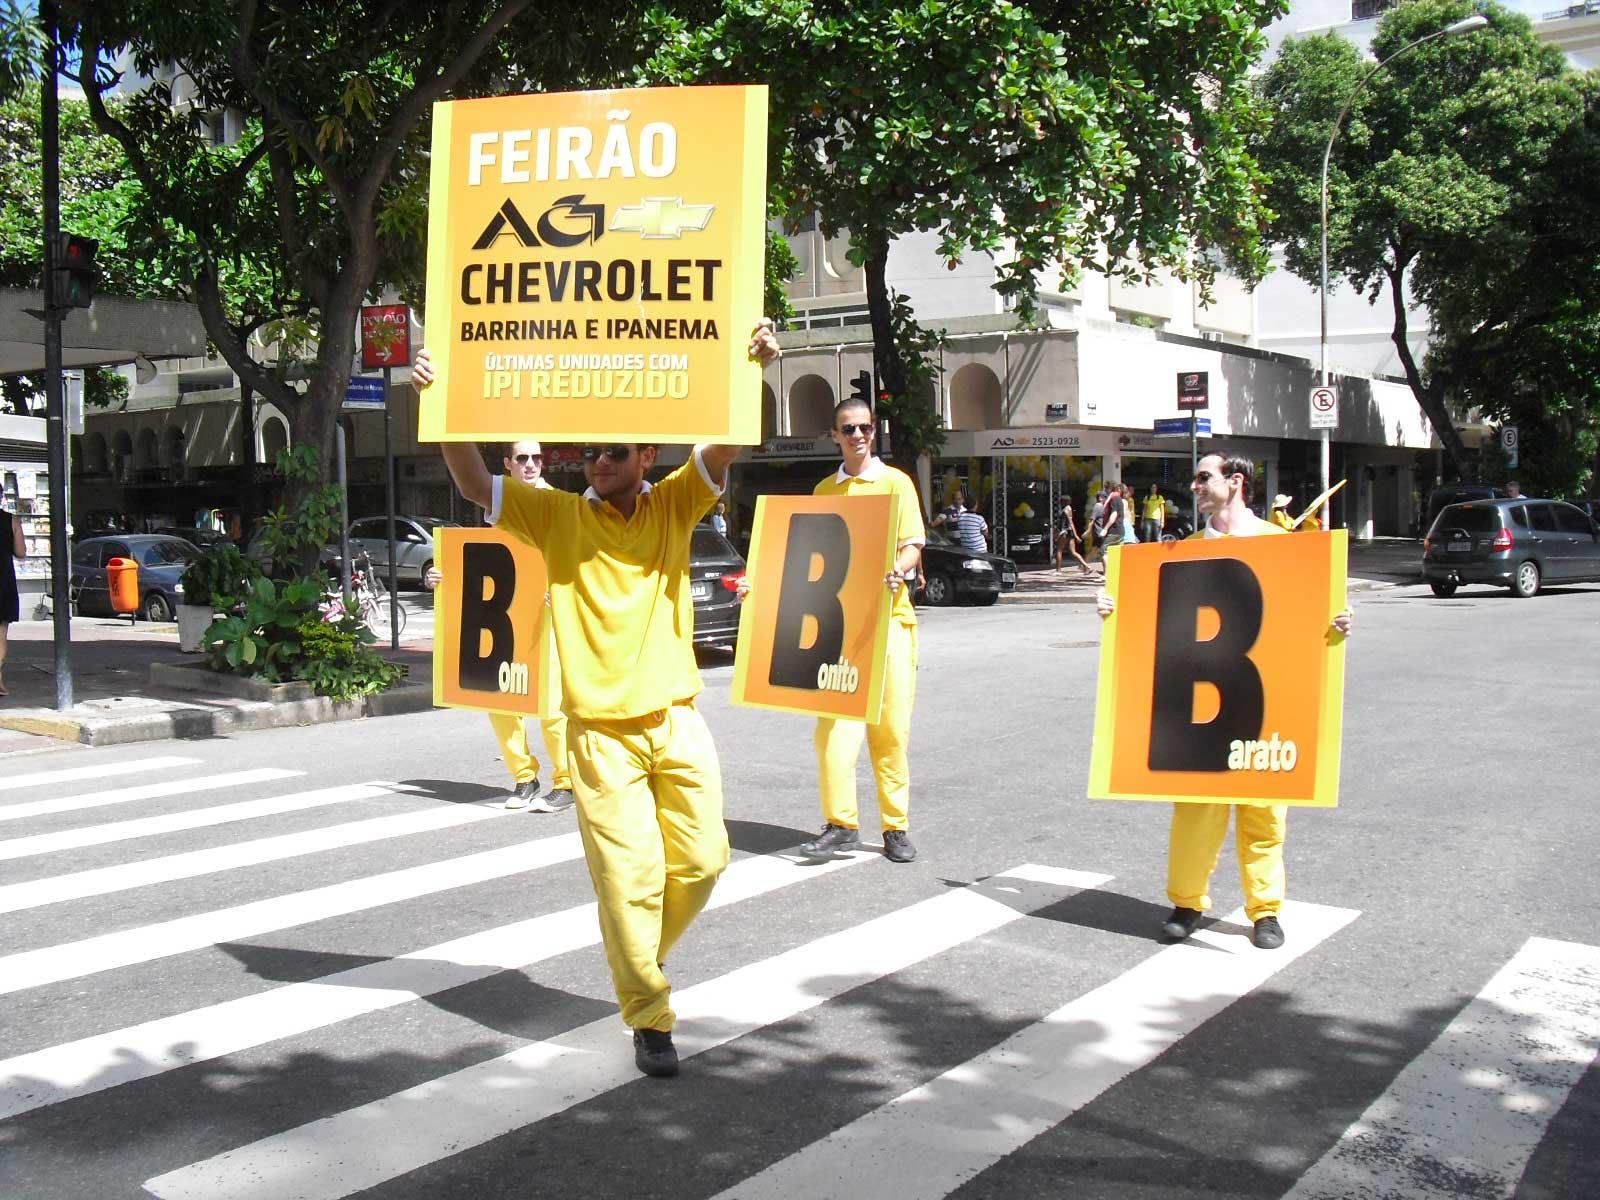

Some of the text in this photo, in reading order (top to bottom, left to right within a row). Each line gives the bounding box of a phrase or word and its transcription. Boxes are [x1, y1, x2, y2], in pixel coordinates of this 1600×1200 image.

[468, 108, 677, 186] FEIRÃO
[471, 194, 605, 249] AG
[461, 259, 722, 305] CHEVROLET
[461, 318, 719, 342] BARRINHA E IPANEMA
[485, 352, 688, 371] ÚLTIMAS UNIDADES COM
[483, 370, 690, 400] IPI REDUZIDO
[1032, 437, 1080, 446] 2523-0928
[1507, 433, 1512, 443] E
